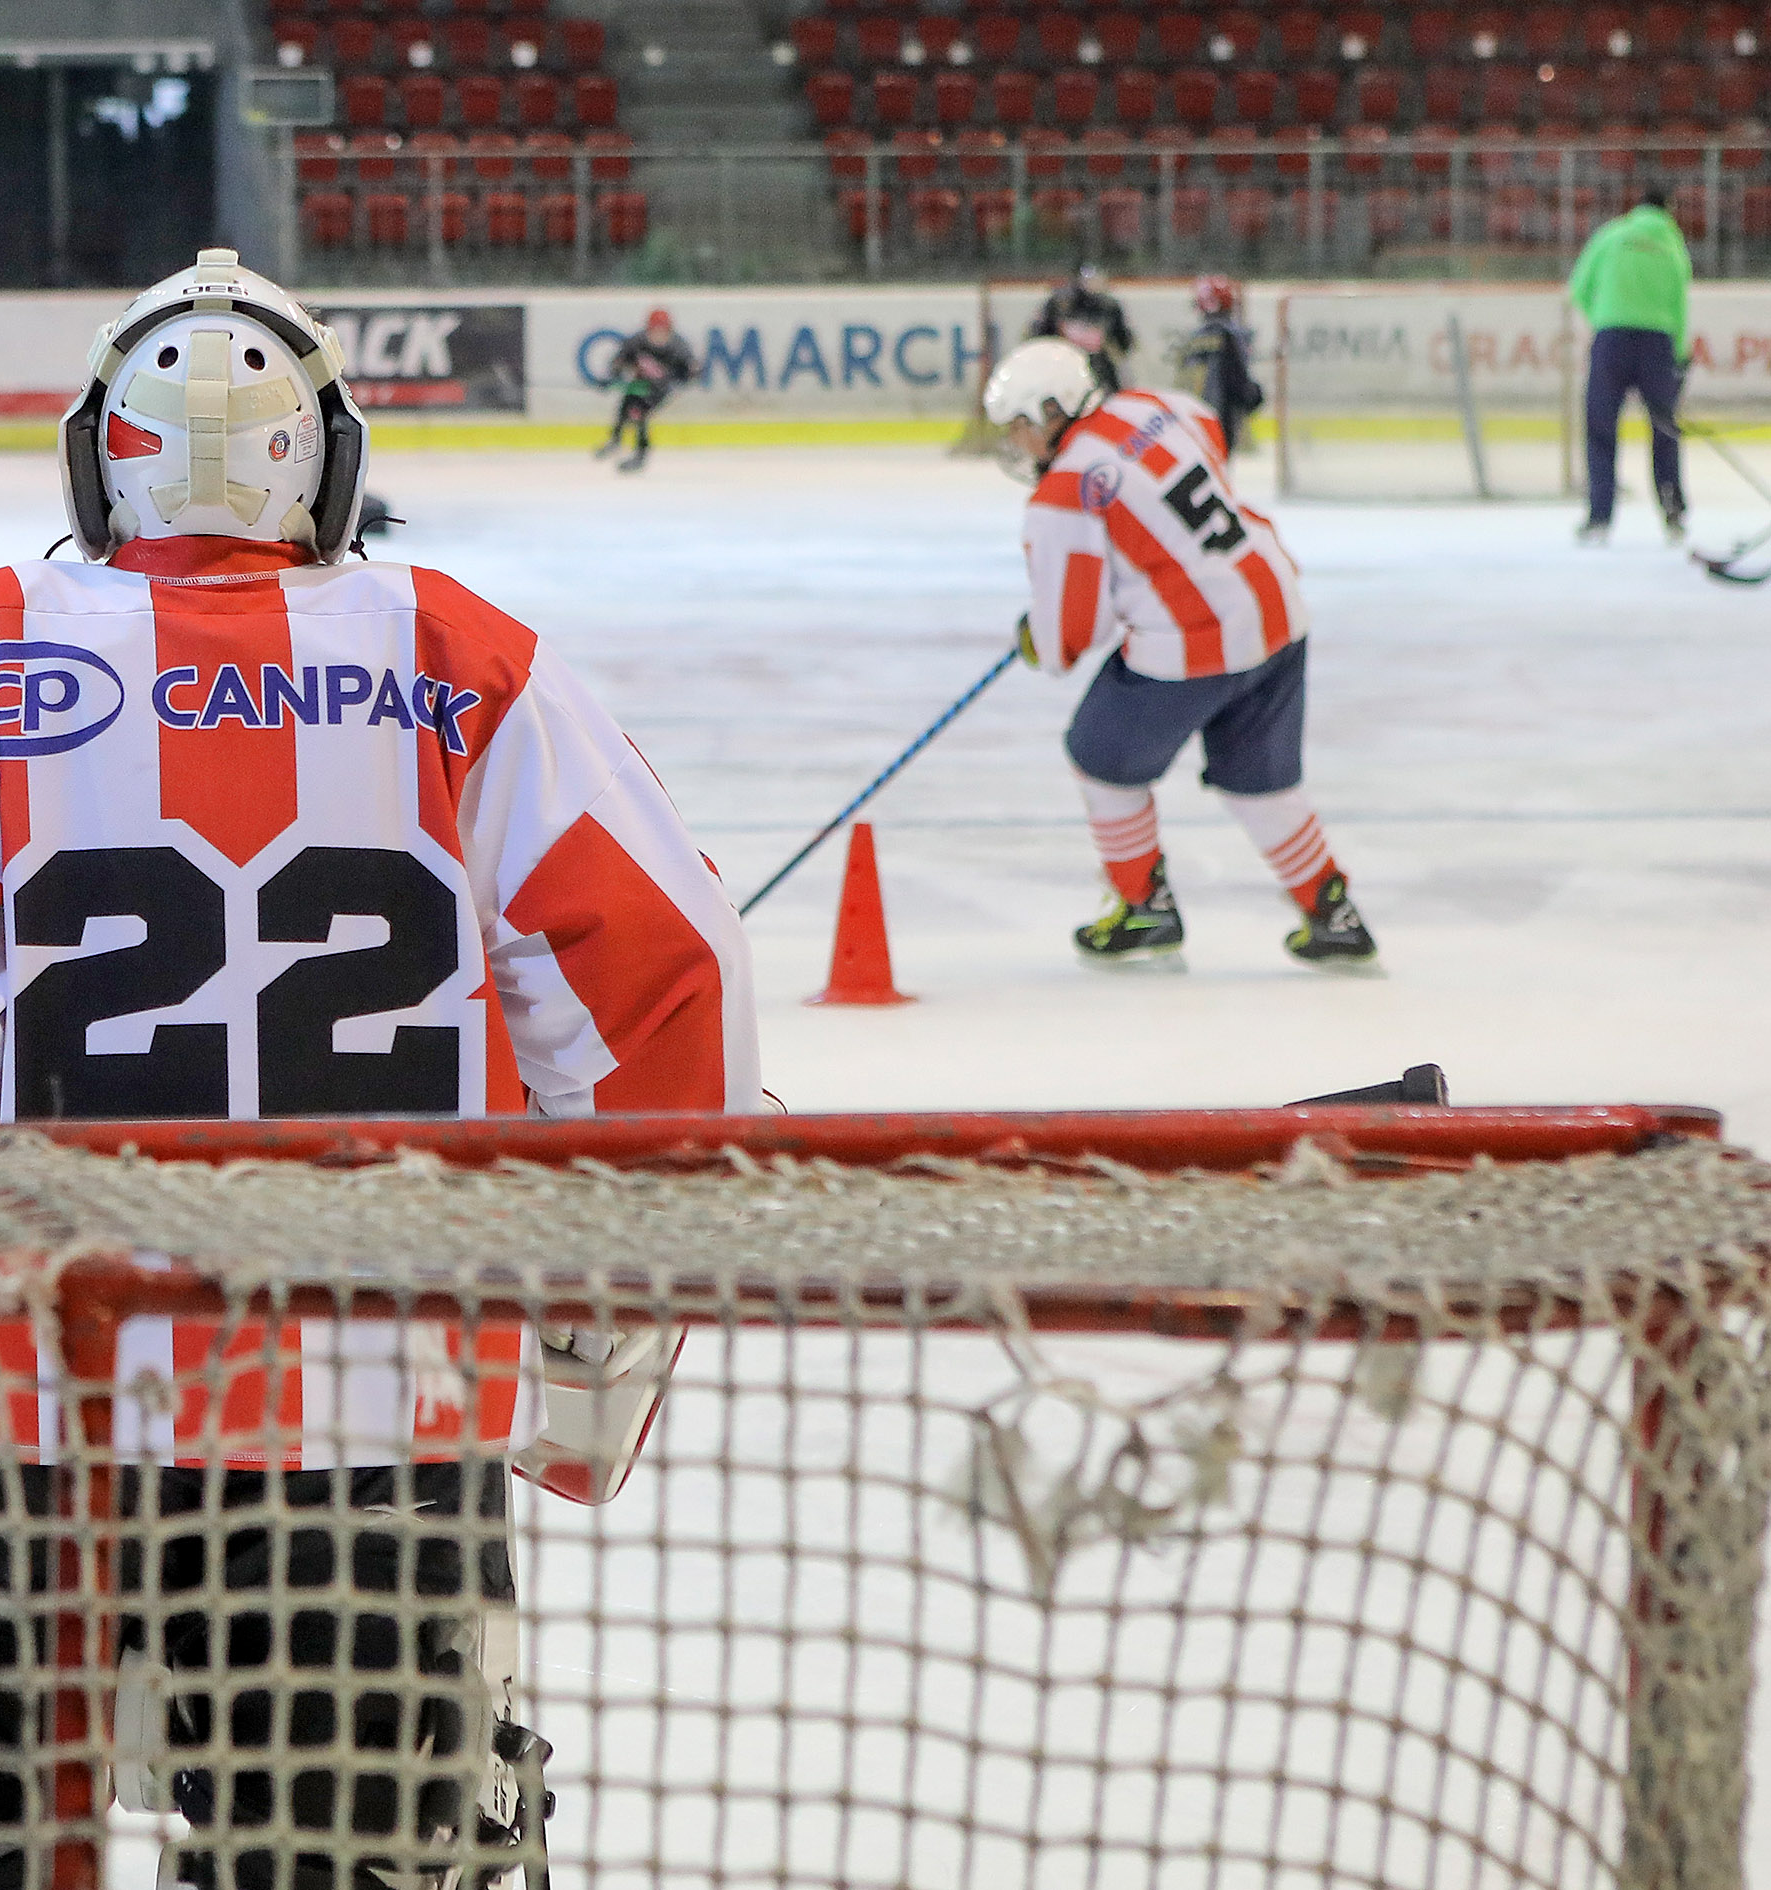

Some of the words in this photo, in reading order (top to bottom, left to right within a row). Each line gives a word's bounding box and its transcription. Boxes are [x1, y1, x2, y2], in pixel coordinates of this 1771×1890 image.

[576, 325, 998, 391] CMARCH
[1164, 464, 1246, 552] 5
[150, 663, 482, 757] CANPACK
[13, 846, 460, 1119] 22
